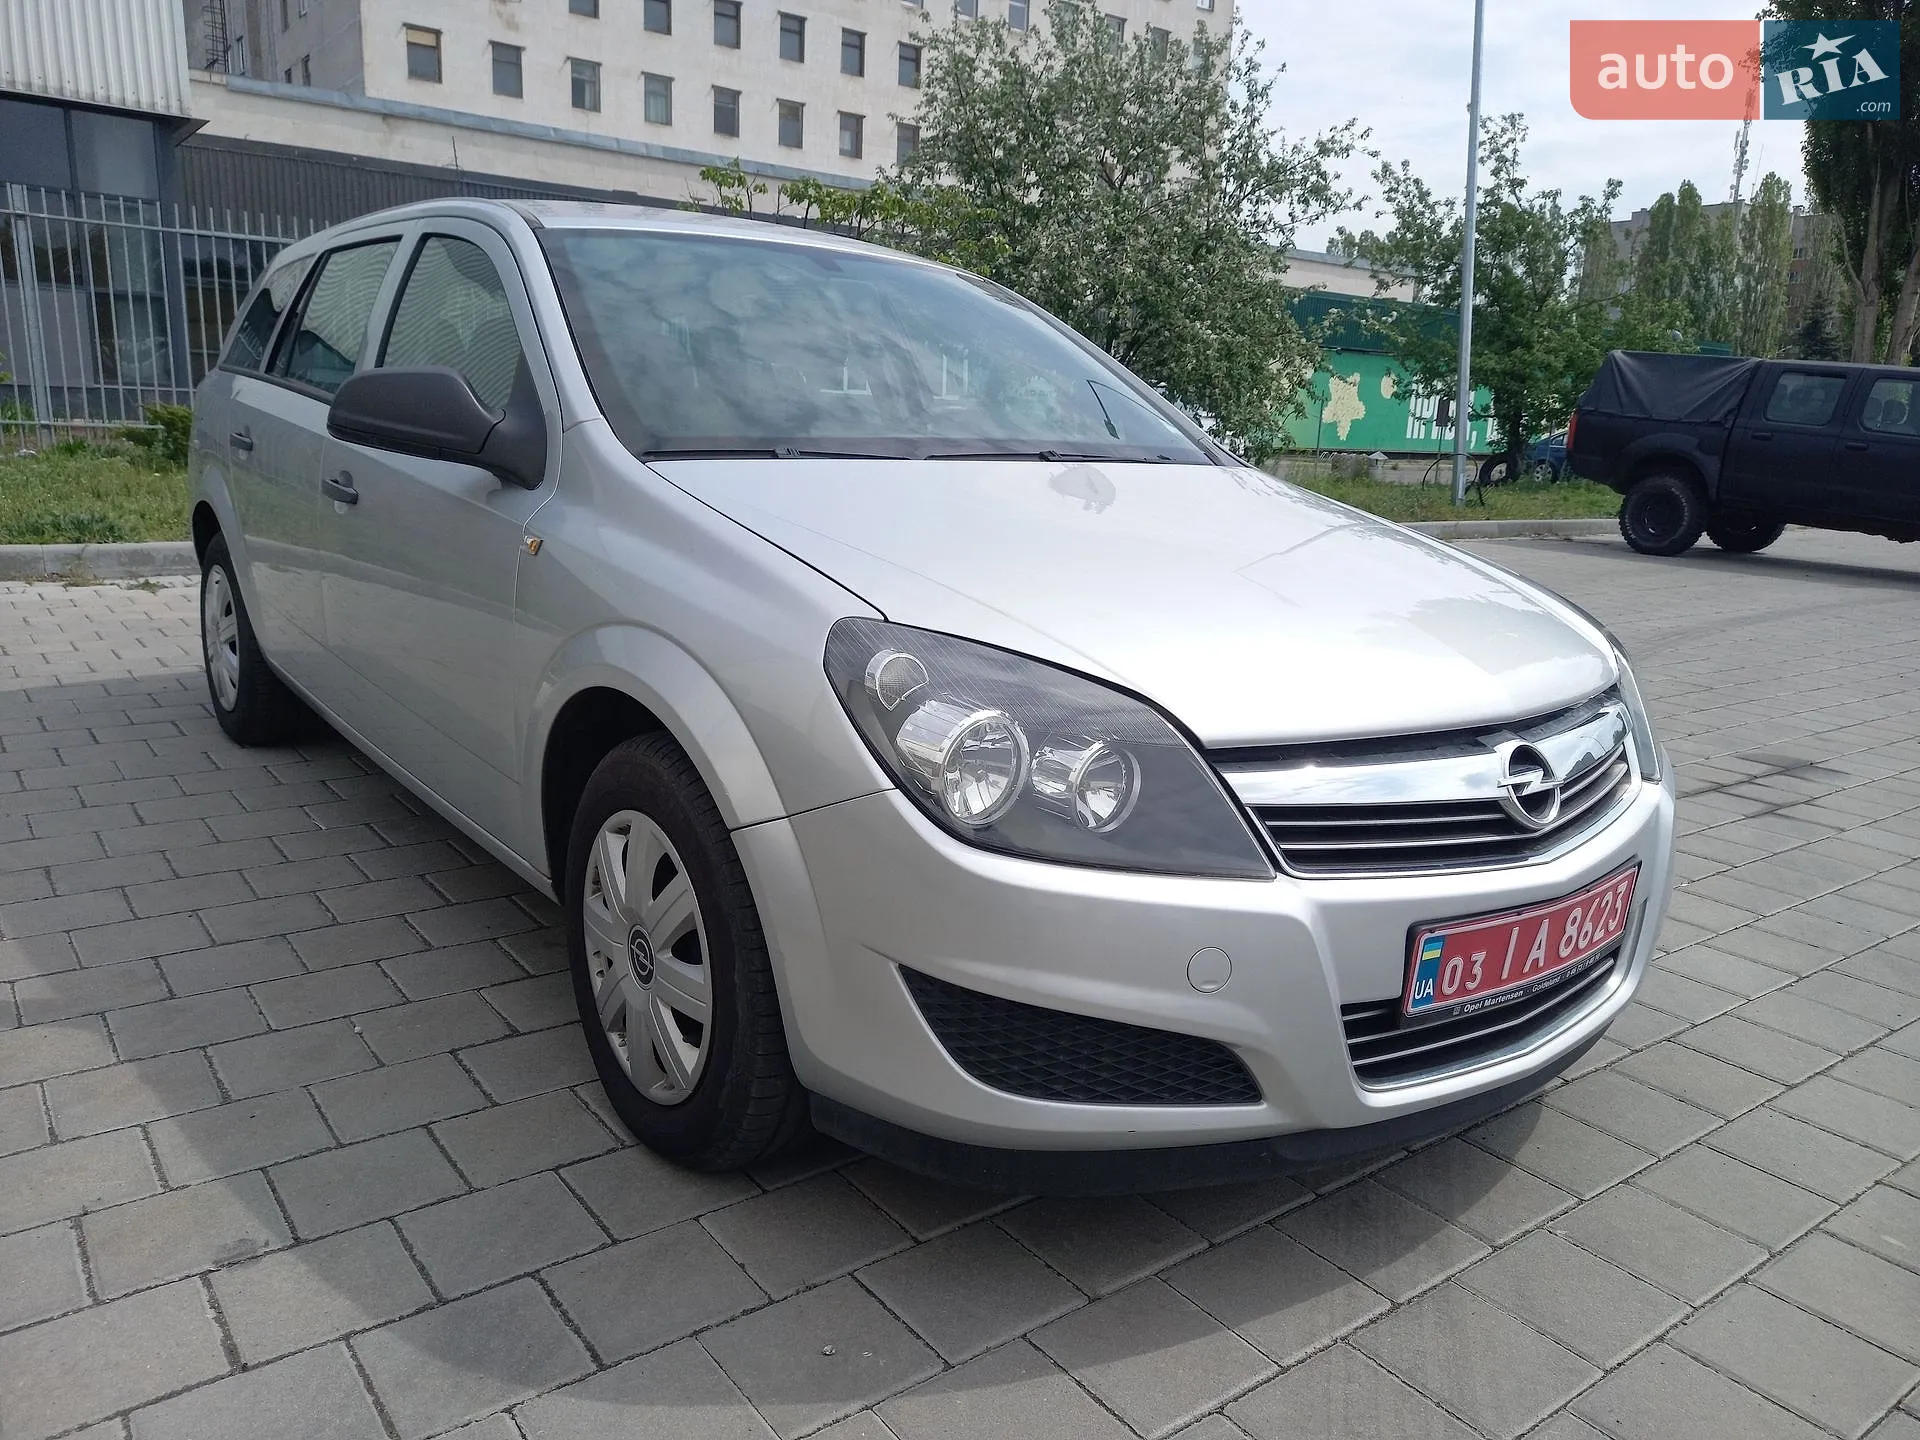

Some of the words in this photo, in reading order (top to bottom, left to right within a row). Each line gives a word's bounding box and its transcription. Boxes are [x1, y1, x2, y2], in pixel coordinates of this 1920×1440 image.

[1441, 951, 1487, 996] 03
[1558, 879, 1629, 959] 8623
[1414, 978, 1434, 1000] UA
[1463, 1001, 1483, 1013] Opel
[1484, 990, 1524, 1008] Martensen
